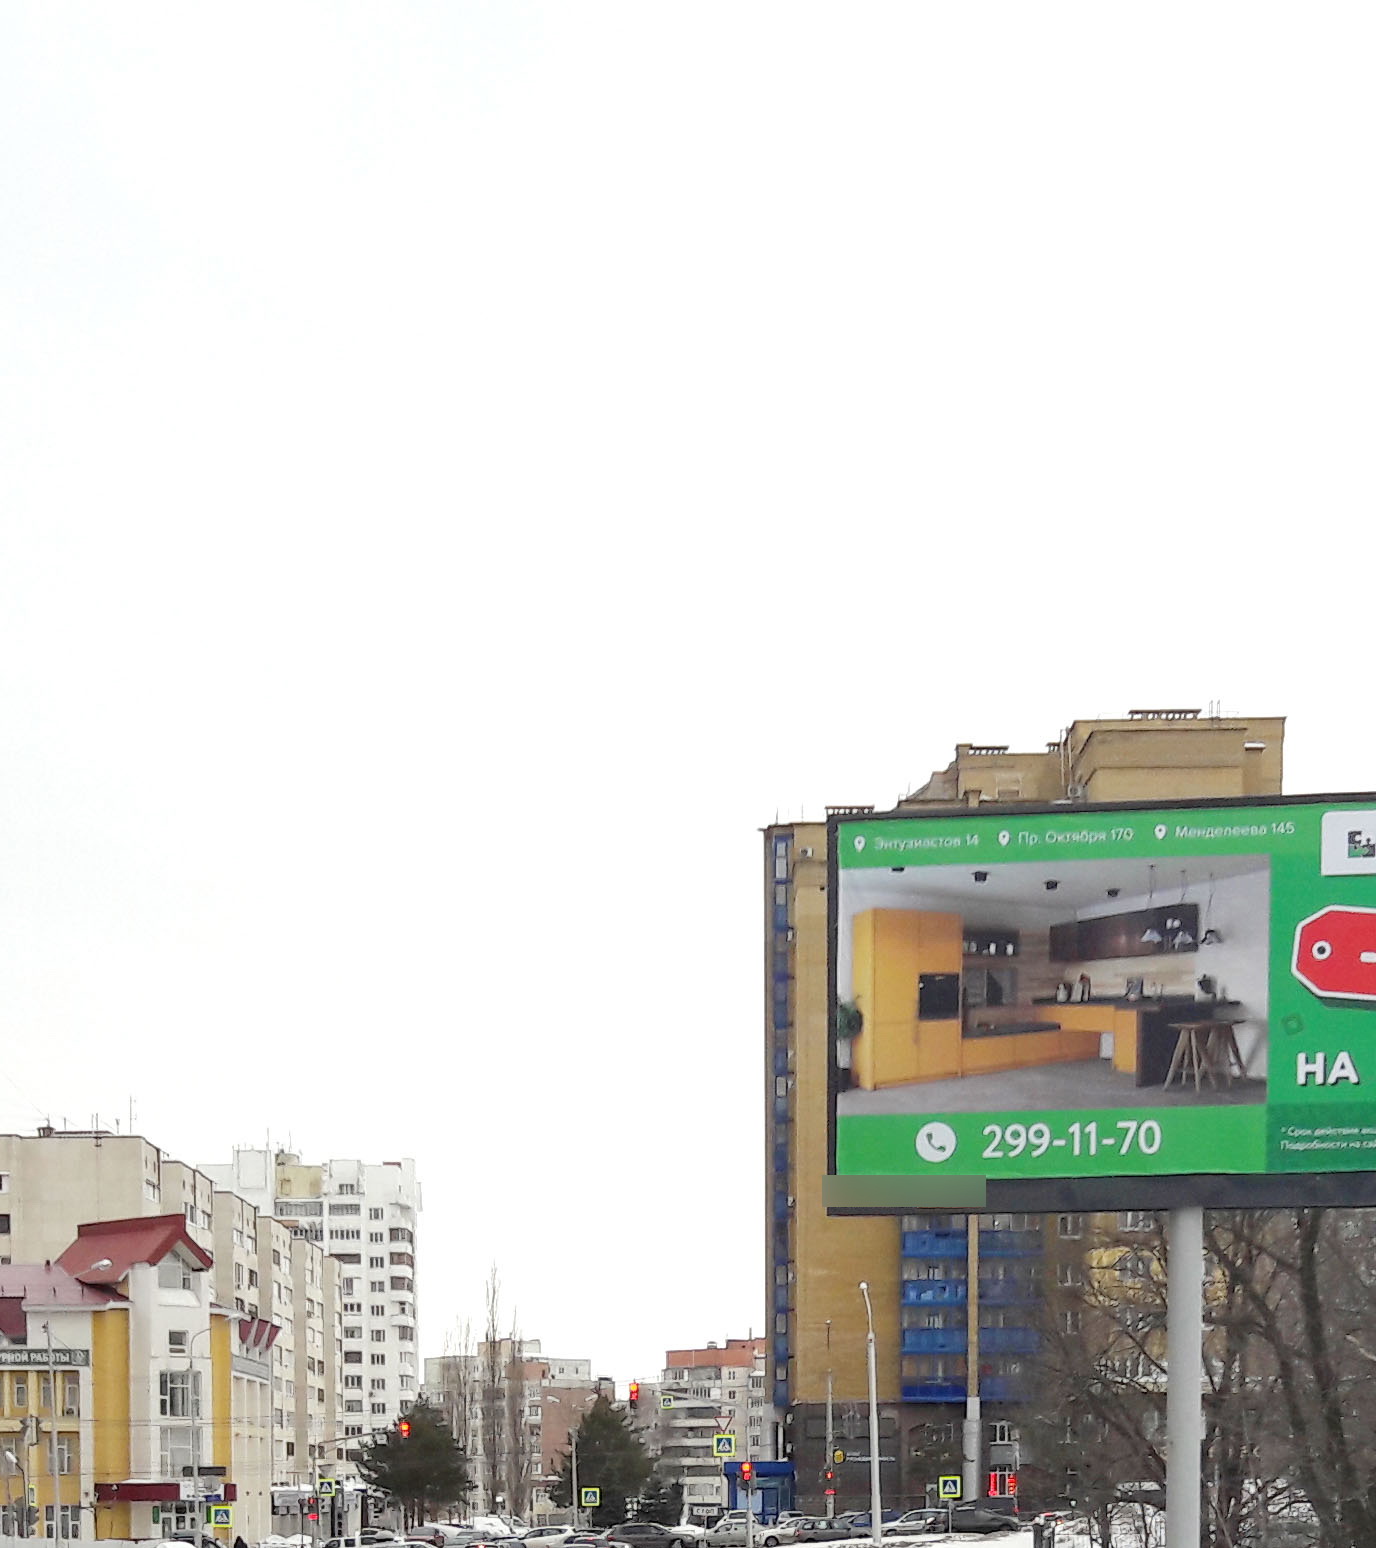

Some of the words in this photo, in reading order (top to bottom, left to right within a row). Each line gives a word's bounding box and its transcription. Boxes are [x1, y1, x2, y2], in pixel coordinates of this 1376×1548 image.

[1045, 830, 1107, 844] Октября
[1110, 828, 1135, 841] 170
[1175, 825, 1267, 839] Менделеева
[1272, 821, 1295, 834] 145
[874, 835, 962, 851] Энтузиастов
[966, 833, 979, 846] 14
[1296, 1051, 1360, 1086] НА
[981, 1119, 1162, 1160] 299-11-70
[30, 1352, 70, 1363] РАБОТЫ
